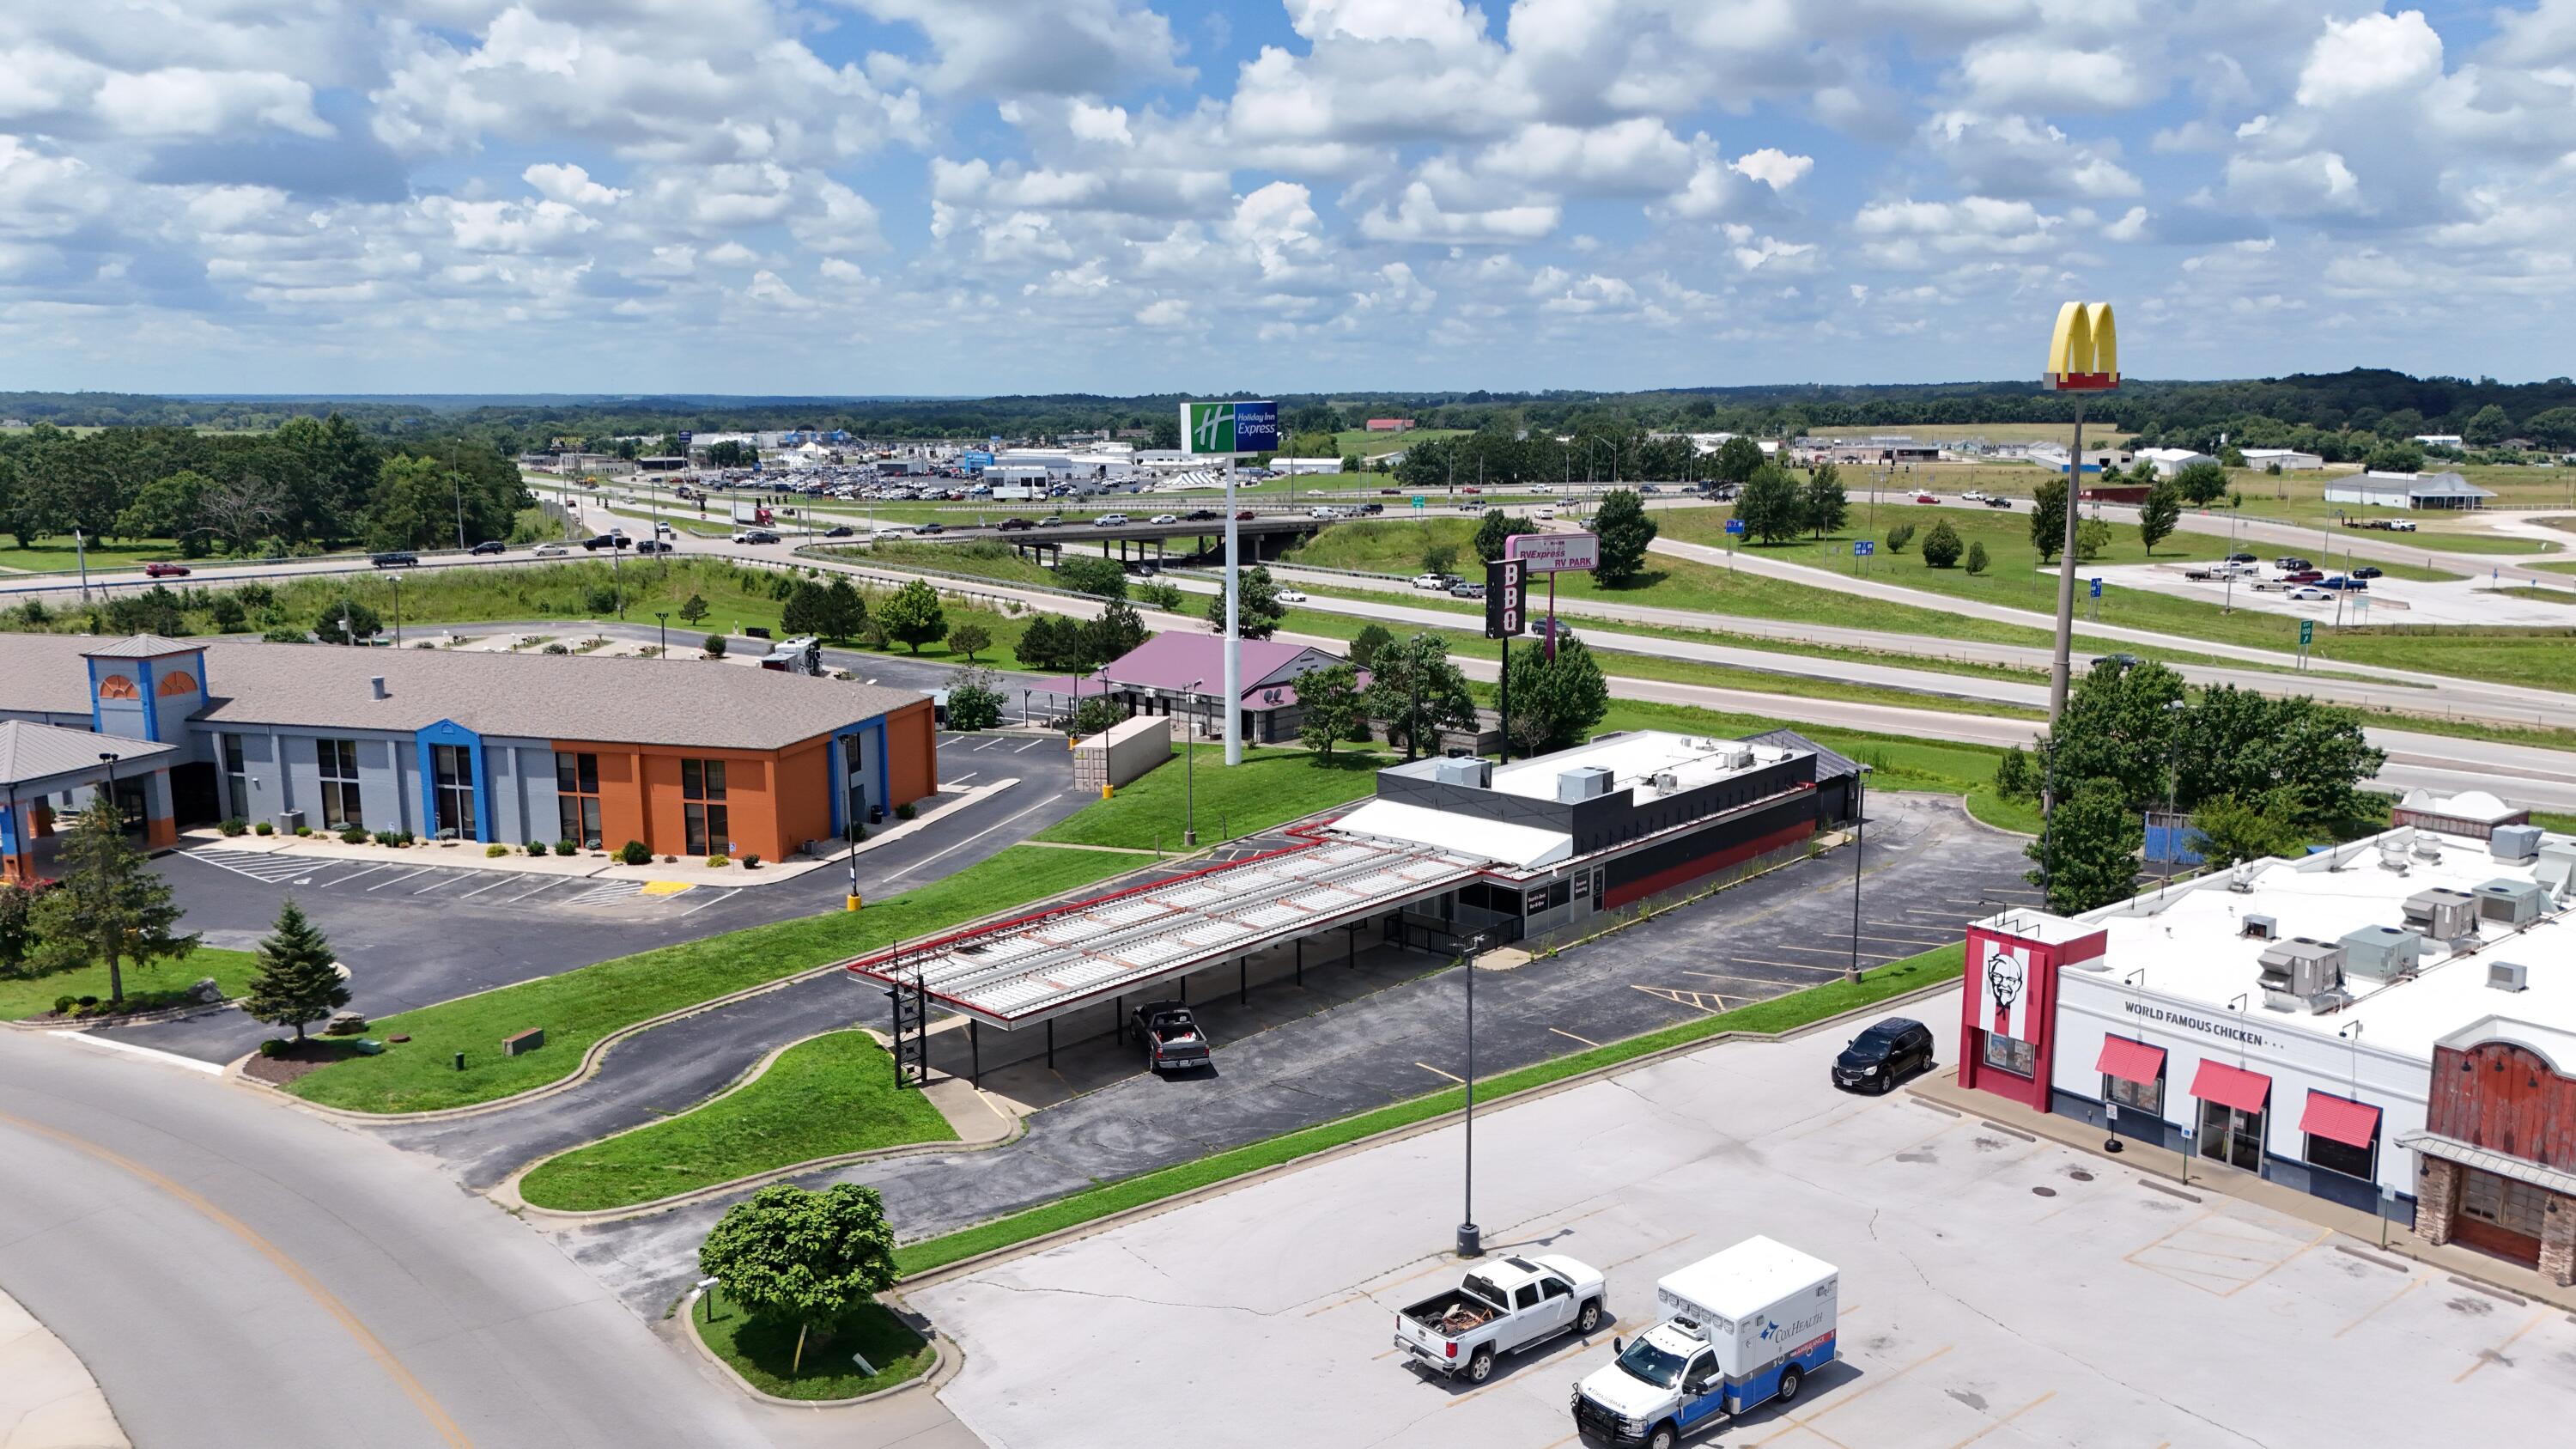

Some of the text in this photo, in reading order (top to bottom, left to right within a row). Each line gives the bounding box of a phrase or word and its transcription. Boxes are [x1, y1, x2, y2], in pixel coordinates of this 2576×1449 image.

[1237, 412, 1276, 423] Holiday Inn
[1238, 422, 1276, 436] Express
[1520, 550, 1566, 560] RVExpress
[1555, 557, 1592, 568] RV PARK
[2124, 1001, 2263, 1046] WORLD FAMOUS CHICKEN
